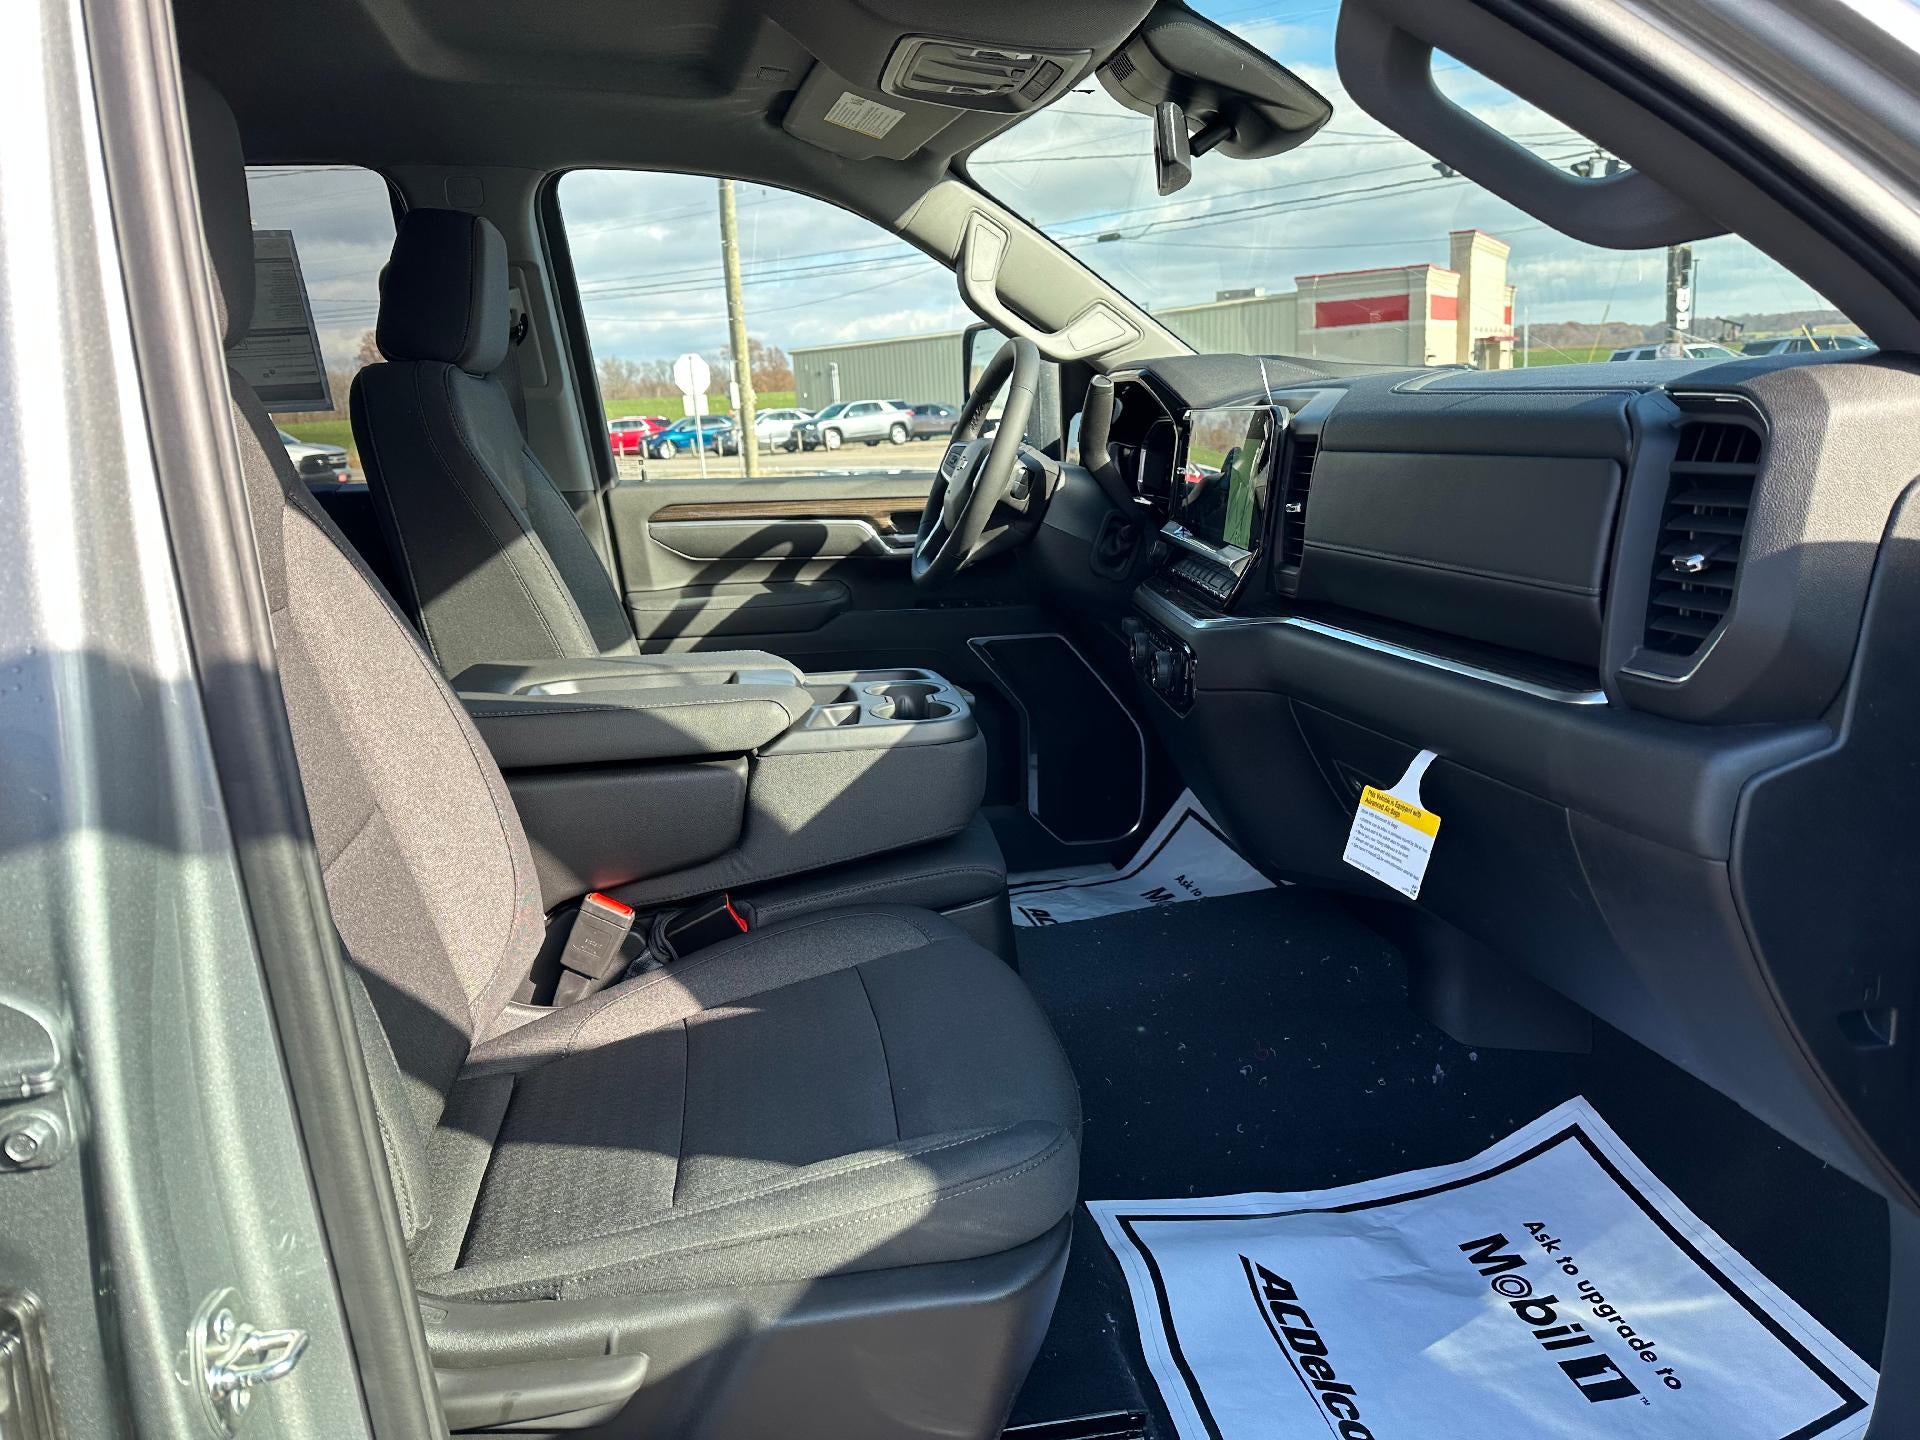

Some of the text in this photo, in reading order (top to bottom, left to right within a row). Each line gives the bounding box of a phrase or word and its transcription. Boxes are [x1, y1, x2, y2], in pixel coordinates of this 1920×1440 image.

[1174, 874, 1194, 890] Ask
[1254, 1260, 1376, 1440] ACDelco
[1458, 1232, 1596, 1352] Mobil
[1522, 1221, 1682, 1390] Ask to upgrade to
